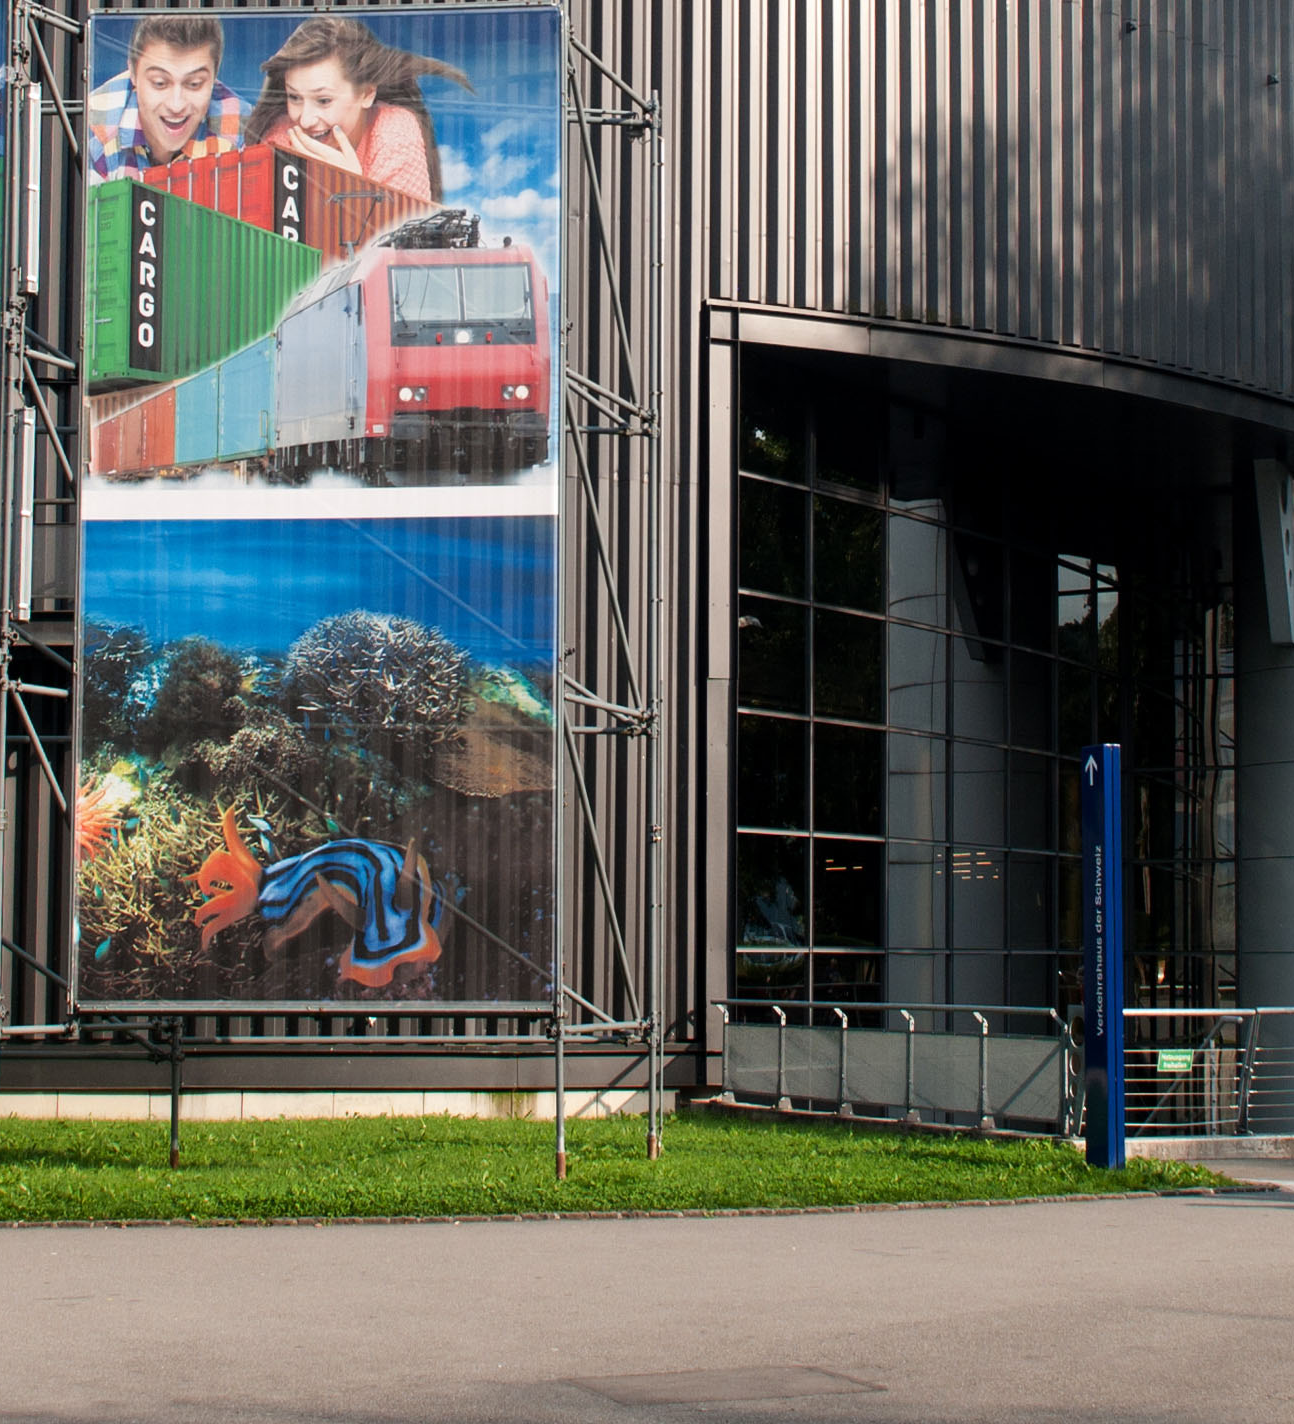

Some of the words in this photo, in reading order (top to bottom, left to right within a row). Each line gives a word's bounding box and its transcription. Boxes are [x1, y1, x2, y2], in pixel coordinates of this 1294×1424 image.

[137, 200, 157, 348] CARGO
[1094, 845, 1103, 906] Schweiz
[1095, 909, 1103, 933] der
[1095, 937, 1104, 1036] Verkehrshaus
